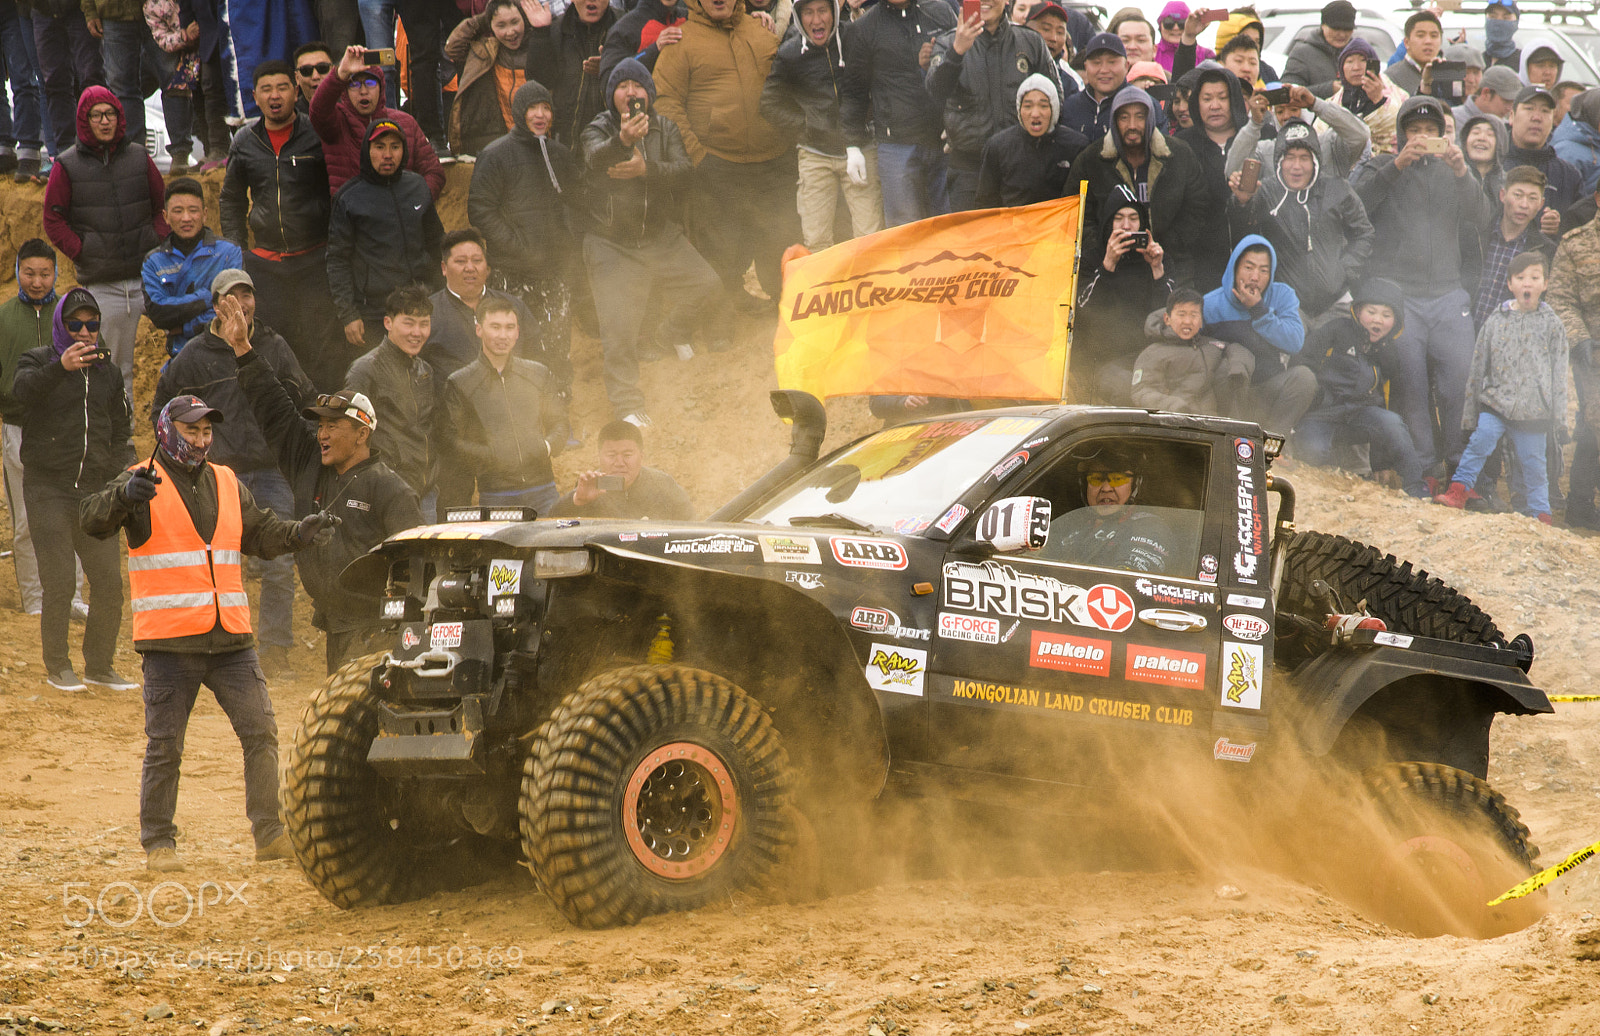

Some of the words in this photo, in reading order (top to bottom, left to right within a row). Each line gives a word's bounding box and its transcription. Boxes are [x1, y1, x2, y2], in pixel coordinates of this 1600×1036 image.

[909, 271, 1001, 287] MONGOLIAN
[965, 278, 1019, 300] CLUB
[982, 503, 1015, 541] 01
[733, 543, 755, 553] CLUB
[841, 541, 900, 562] ARB
[1130, 535, 1166, 553] NISSAN
[489, 564, 517, 590] RAW
[785, 570, 821, 583] FOX
[946, 576, 1081, 623] BRISK
[855, 611, 885, 625] ARB
[942, 615, 997, 635] G-FORCE
[1231, 618, 1263, 633] Hi-Lift
[432, 624, 462, 638] G-FORCE
[886, 624, 931, 641] sport
[941, 628, 973, 640] RACING
[974, 633, 996, 643] GEAR
[431, 638, 448, 647] RACING
[1037, 641, 1105, 662] pakelo
[872, 650, 918, 676] RAW
[1133, 654, 1199, 675] pakelo
[1227, 652, 1249, 704] RAW
[952, 680, 1040, 706] MONGOLIAN
[1044, 692, 1084, 712] LAND
[1088, 697, 1151, 721] CRUISER
[1155, 705, 1193, 726] CLUB
